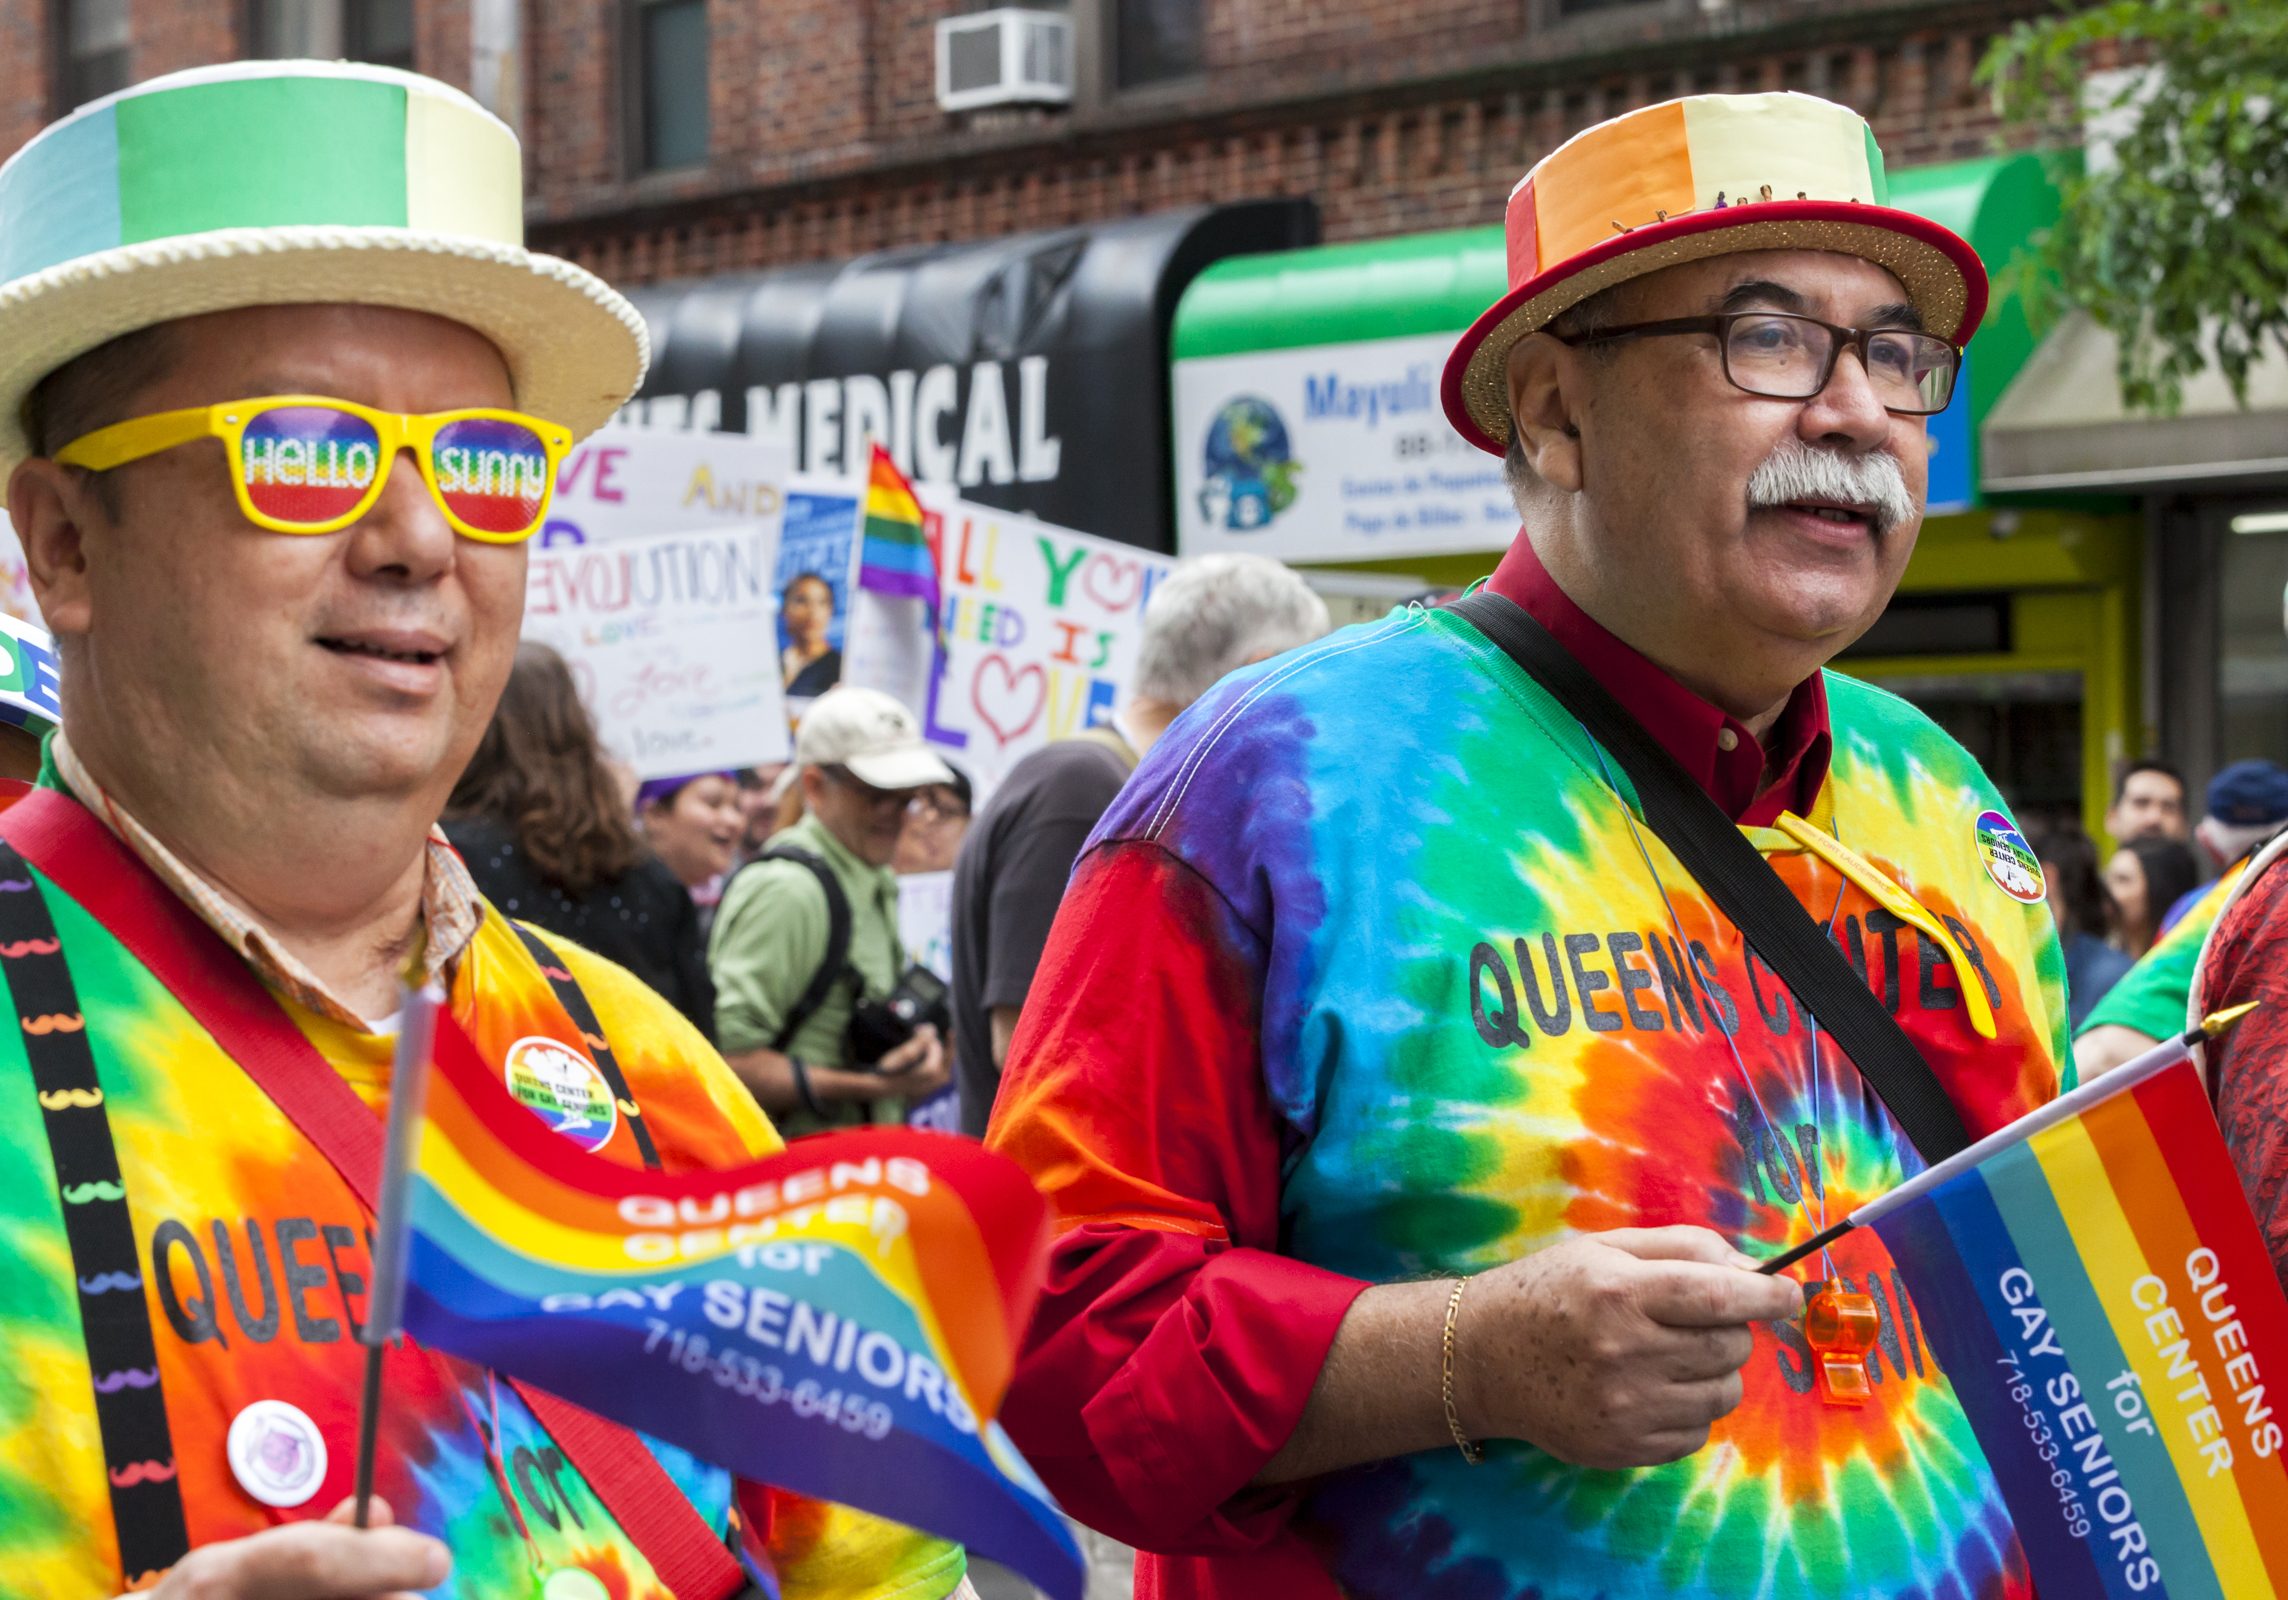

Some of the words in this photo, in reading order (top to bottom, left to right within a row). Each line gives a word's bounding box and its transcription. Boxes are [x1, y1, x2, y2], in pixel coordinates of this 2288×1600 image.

[745, 356, 1061, 487] MEDICAL
[556, 447, 629, 504] VE
[529, 538, 761, 615] EVOLUTION
[1052, 620, 1114, 668] IS
[1981, 833, 2011, 853] SENIORS
[1989, 847, 2016, 866] CENTER
[1470, 931, 1741, 1050] QUEENS
[1744, 908, 2001, 1036] CNTER
[555, 1082, 594, 1100] CENTER
[619, 1157, 930, 1227] QUEENS
[1738, 1097, 1825, 1206] for
[623, 1193, 909, 1262] CENTER
[734, 1239, 834, 1276] for
[152, 1219, 378, 1351] QUEE
[643, 1319, 892, 1440] 718-533-6459
[703, 1279, 979, 1434] SENIORS
[2131, 1274, 2234, 1478] CENTER
[2186, 1247, 2283, 1459] QUEENS
[1997, 1350, 2091, 1538] 718-533-6459
[2000, 1267, 2064, 1358] GAY
[2047, 1372, 2160, 1591] SENIORS
[2106, 1370, 2155, 1437] for
